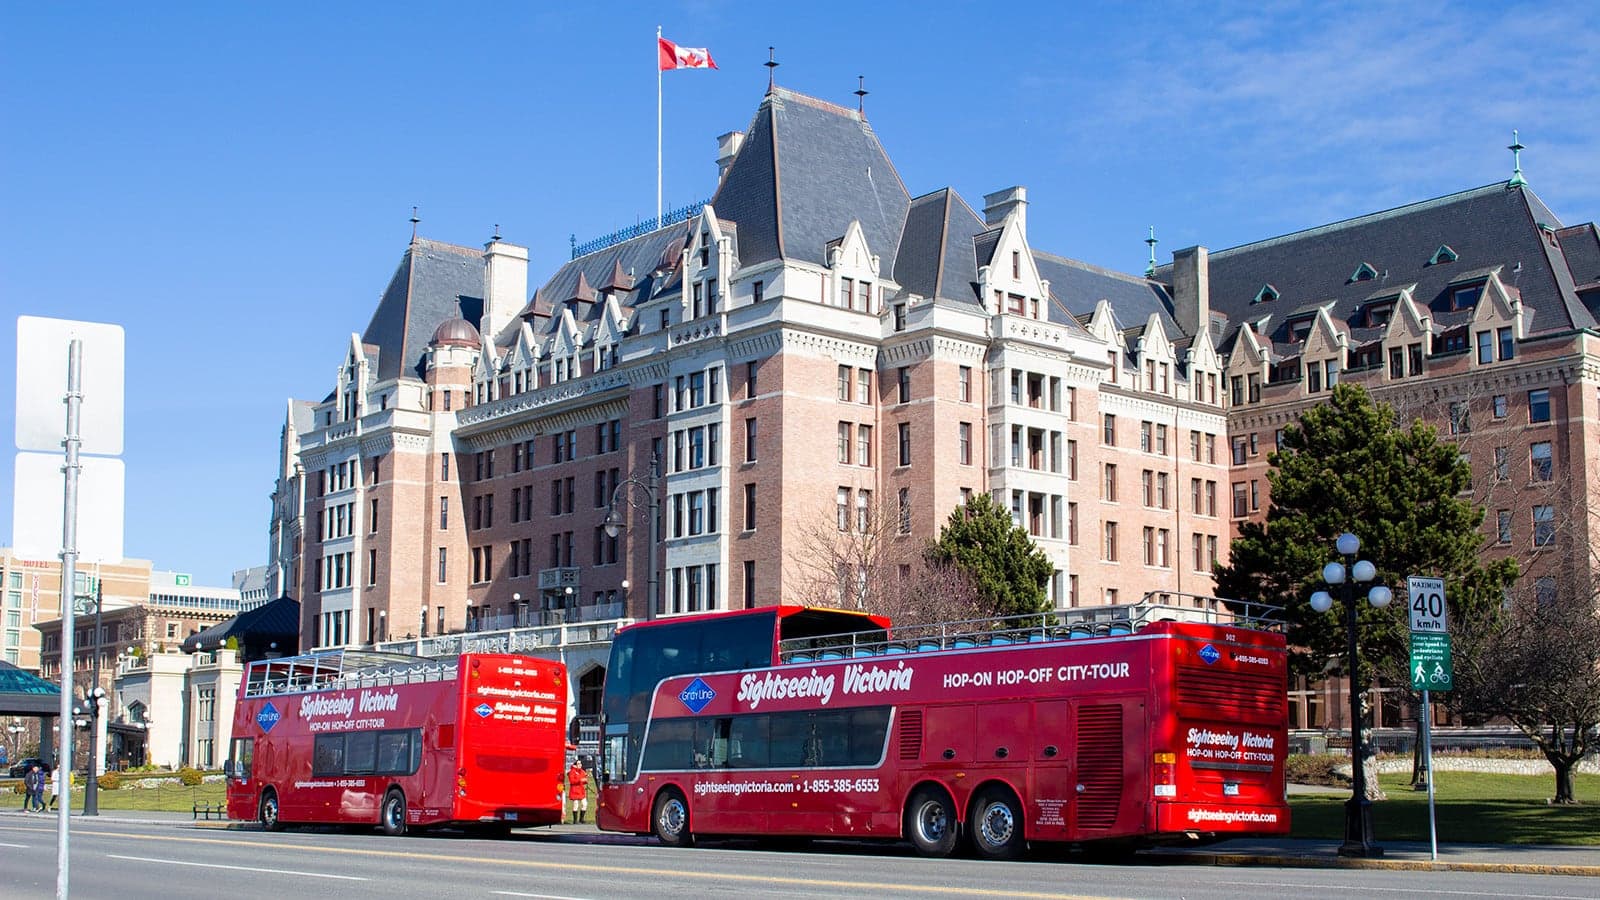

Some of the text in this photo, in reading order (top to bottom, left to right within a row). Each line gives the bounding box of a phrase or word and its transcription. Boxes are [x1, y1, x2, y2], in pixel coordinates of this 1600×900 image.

[1413, 593, 1442, 618] 40
[1417, 619, 1440, 629] km/h
[943, 662, 1130, 688] HOP-ON HOP-OFF CITY-TOUR
[737, 661, 914, 710] Sightseeing Victoria
[299, 688, 399, 721] Sightseeing Victoria
[309, 718, 385, 731] HOP-ON HOP-OFF CITY-TOUR
[1186, 727, 1274, 750] Sightseeing Victoria
[1186, 748, 1275, 762] HOP-ON HOP-OFF CITY-TOUR
[694, 778, 880, 796] sightseeingvictoria.com 1-855-385-6553
[1187, 808, 1277, 824] sightseeingvictoria.com
